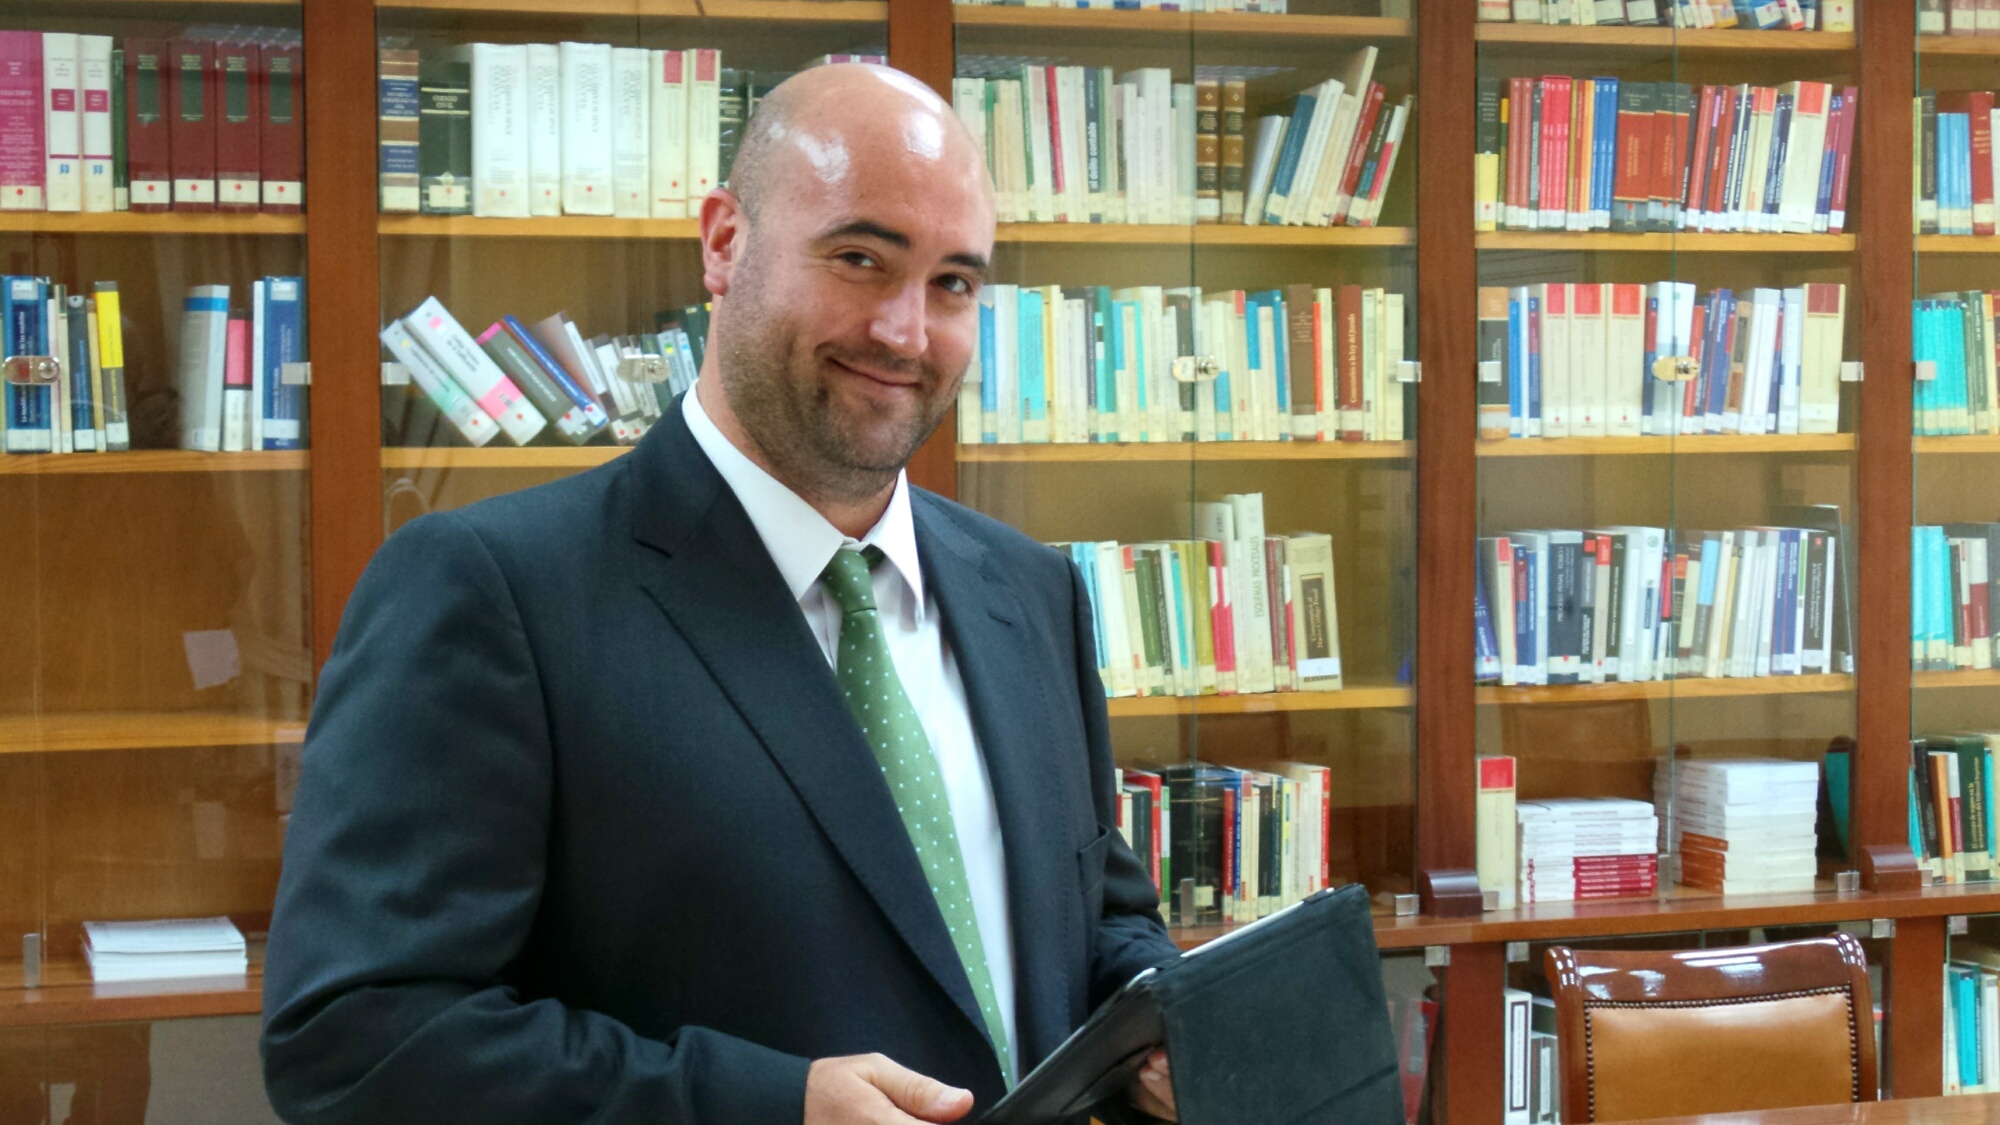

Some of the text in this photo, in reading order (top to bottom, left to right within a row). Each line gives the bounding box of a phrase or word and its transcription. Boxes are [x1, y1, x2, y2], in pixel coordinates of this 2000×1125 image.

[1087, 122, 1097, 156] contable
[1251, 536, 1264, 617] ESQUEMAS PROCESALES
